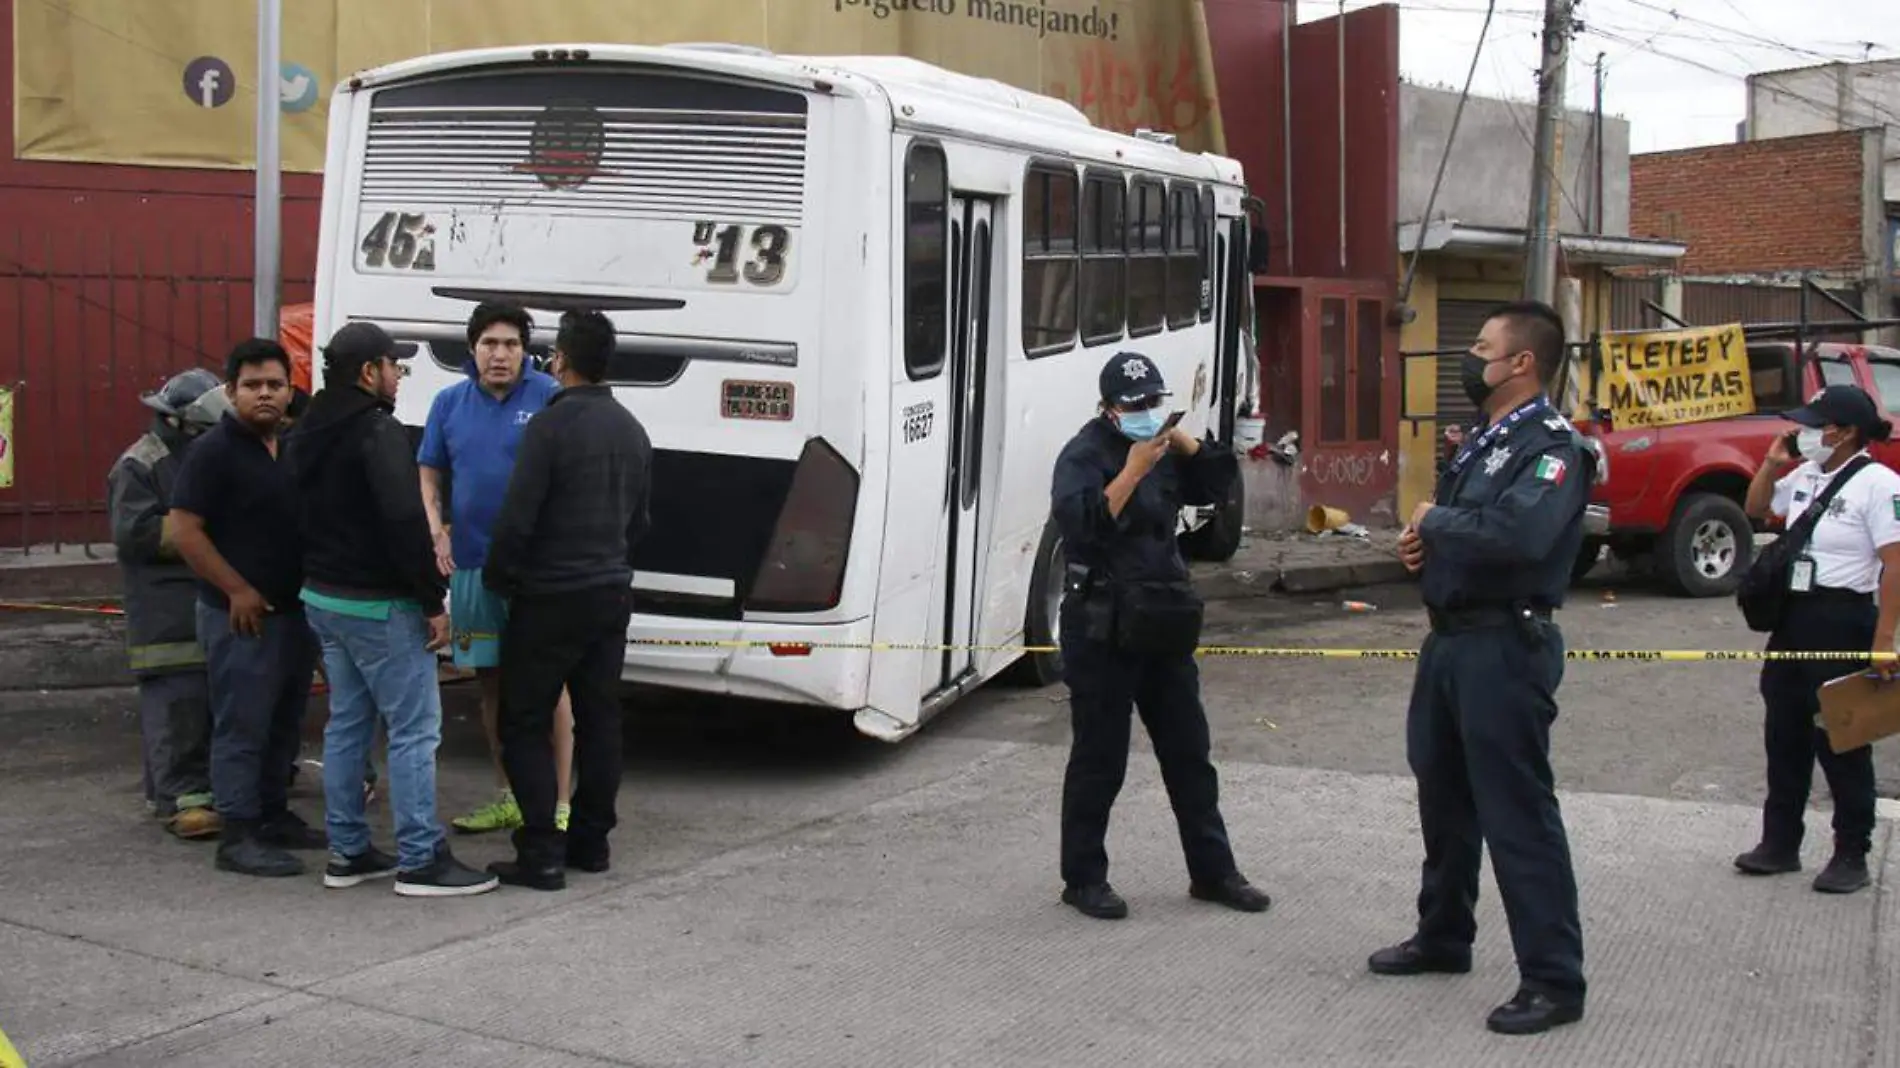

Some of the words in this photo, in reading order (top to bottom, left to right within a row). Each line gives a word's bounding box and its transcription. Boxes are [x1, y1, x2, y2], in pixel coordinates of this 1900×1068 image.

[967, 0, 1119, 41] manejando!
[706, 224, 789, 287] 13
[1609, 336, 1710, 373] FLETES
[1718, 331, 1734, 361] Y
[1610, 370, 1744, 410] MUDANZAS
